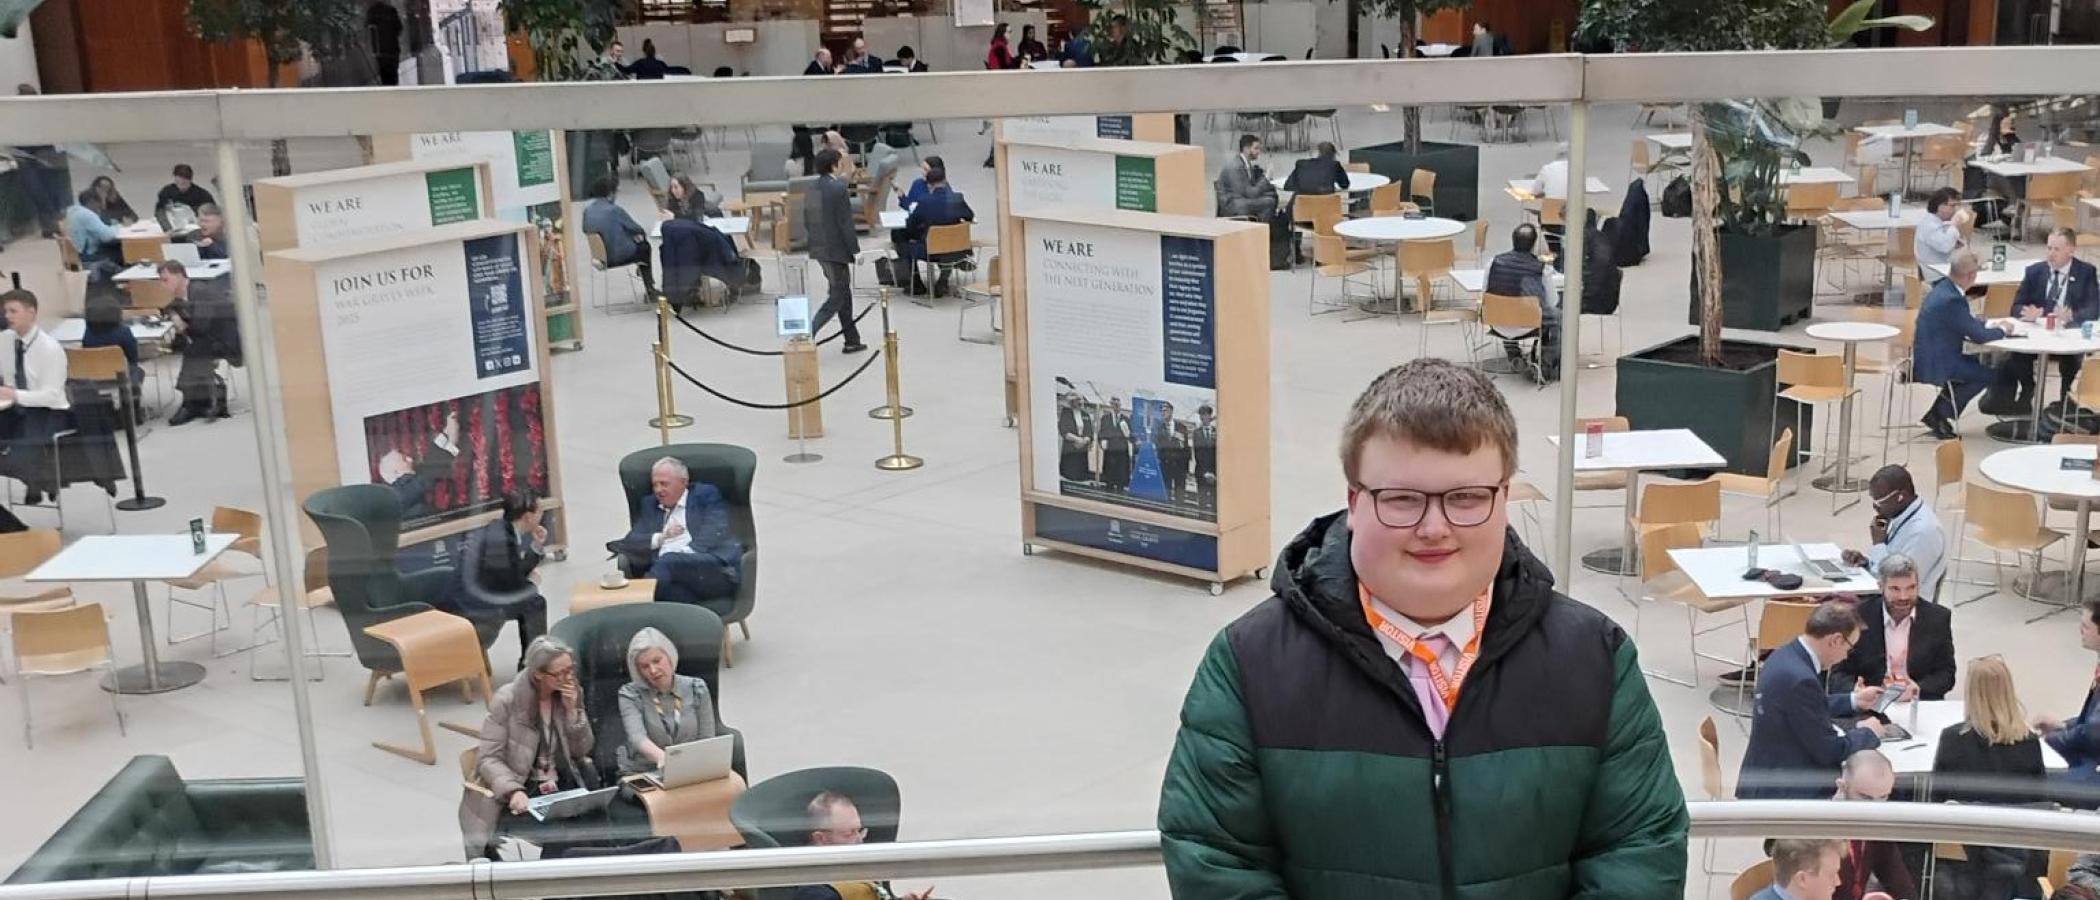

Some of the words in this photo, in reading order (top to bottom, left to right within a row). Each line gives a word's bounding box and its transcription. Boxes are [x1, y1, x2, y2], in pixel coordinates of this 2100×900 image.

[420, 135, 438, 146] WE
[1021, 160, 1039, 174] WE
[1041, 163, 1063, 176] ARE
[308, 200, 332, 214] WE
[336, 197, 362, 212] ARE
[1042, 238, 1063, 254] WE
[1067, 242, 1094, 257] ARE
[333, 274, 373, 296] JOIN
[376, 269, 397, 286] US
[400, 263, 435, 282] FOR
[1042, 258, 1111, 277] CONNECTING
[1112, 267, 1139, 279] WITH
[1043, 273, 1061, 286] THE
[1063, 276, 1088, 289] NEXT
[1091, 279, 1156, 296] GENERATION
[1378, 620, 1416, 651] VISITOR
[1429, 660, 1450, 699] VISITOR
[1451, 653, 1476, 688] VISITOR
